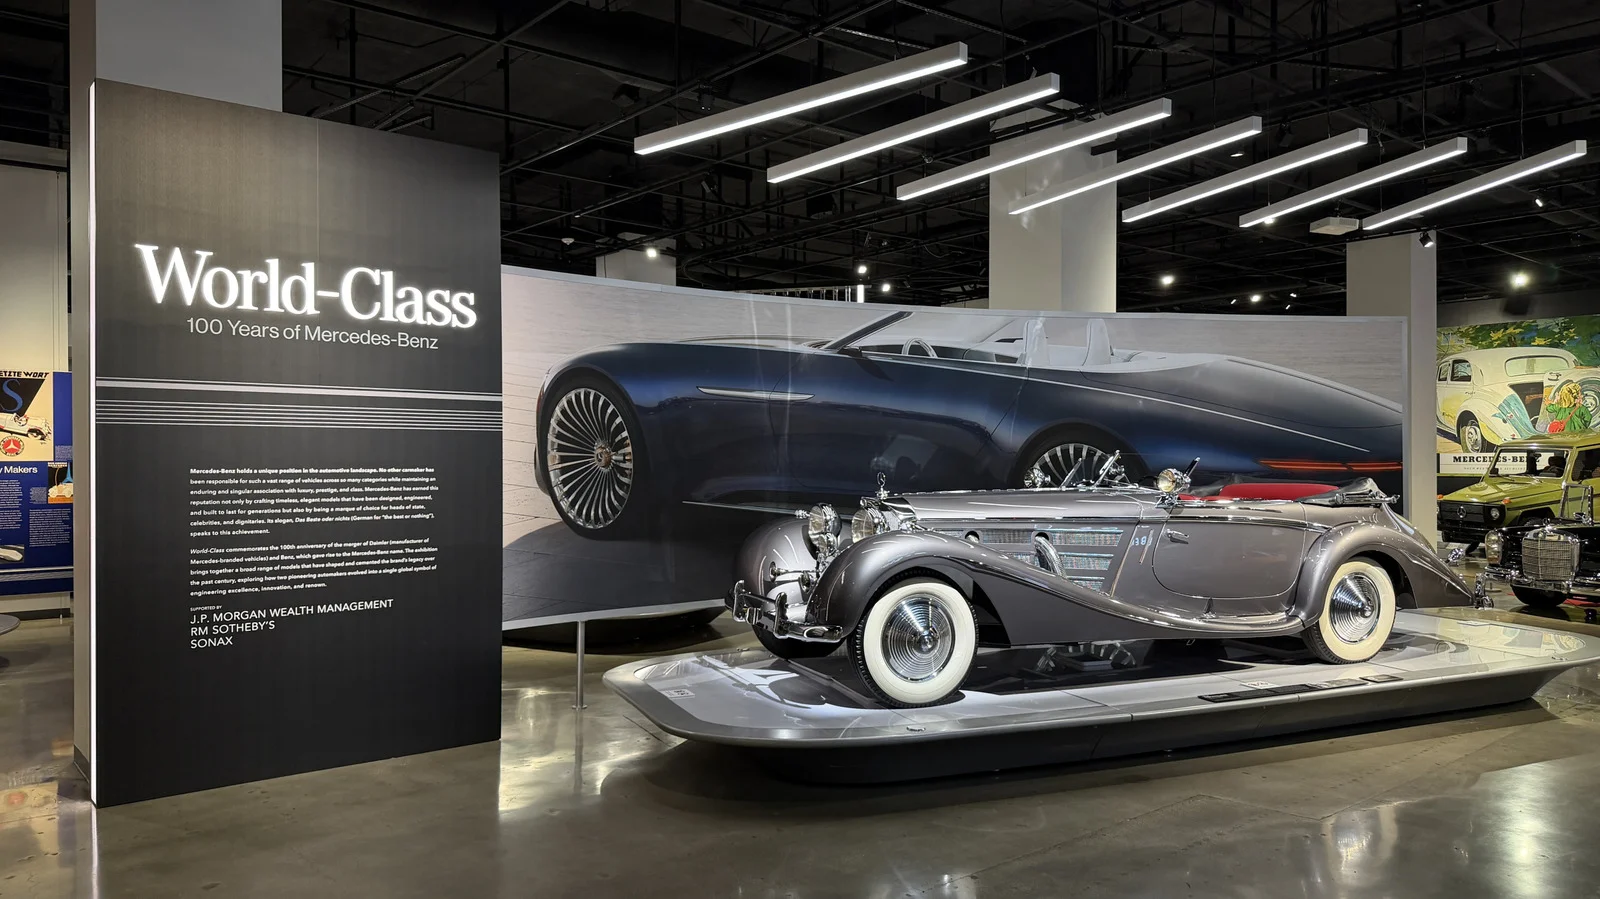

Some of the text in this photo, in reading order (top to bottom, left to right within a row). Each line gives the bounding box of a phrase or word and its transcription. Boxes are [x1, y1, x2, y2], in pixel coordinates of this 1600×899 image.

[135, 243, 477, 329] World-Class
[187, 317, 439, 350] 100 Years of Mercedes-Benz
[4, 465, 38, 474] Makers
[258, 467, 278, 475] unique
[279, 467, 302, 475] position
[190, 488, 216, 496] enduring
[230, 488, 252, 496] singular
[232, 498, 244, 506] only
[247, 508, 281, 516] generations
[190, 530, 211, 538] speaks
[190, 547, 225, 555] World-Class
[190, 556, 244, 565] Mercedes-branded
[210, 567, 234, 575] together
[240, 565, 256, 573] broad
[238, 576, 264, 584] exploring
[190, 588, 226, 597] engineering
[190, 599, 394, 624] J.P. MORGAN WEALTH MANAGEMENT
[190, 620, 275, 636] RM SOTHEBY'S
[190, 636, 233, 649] SONAX
